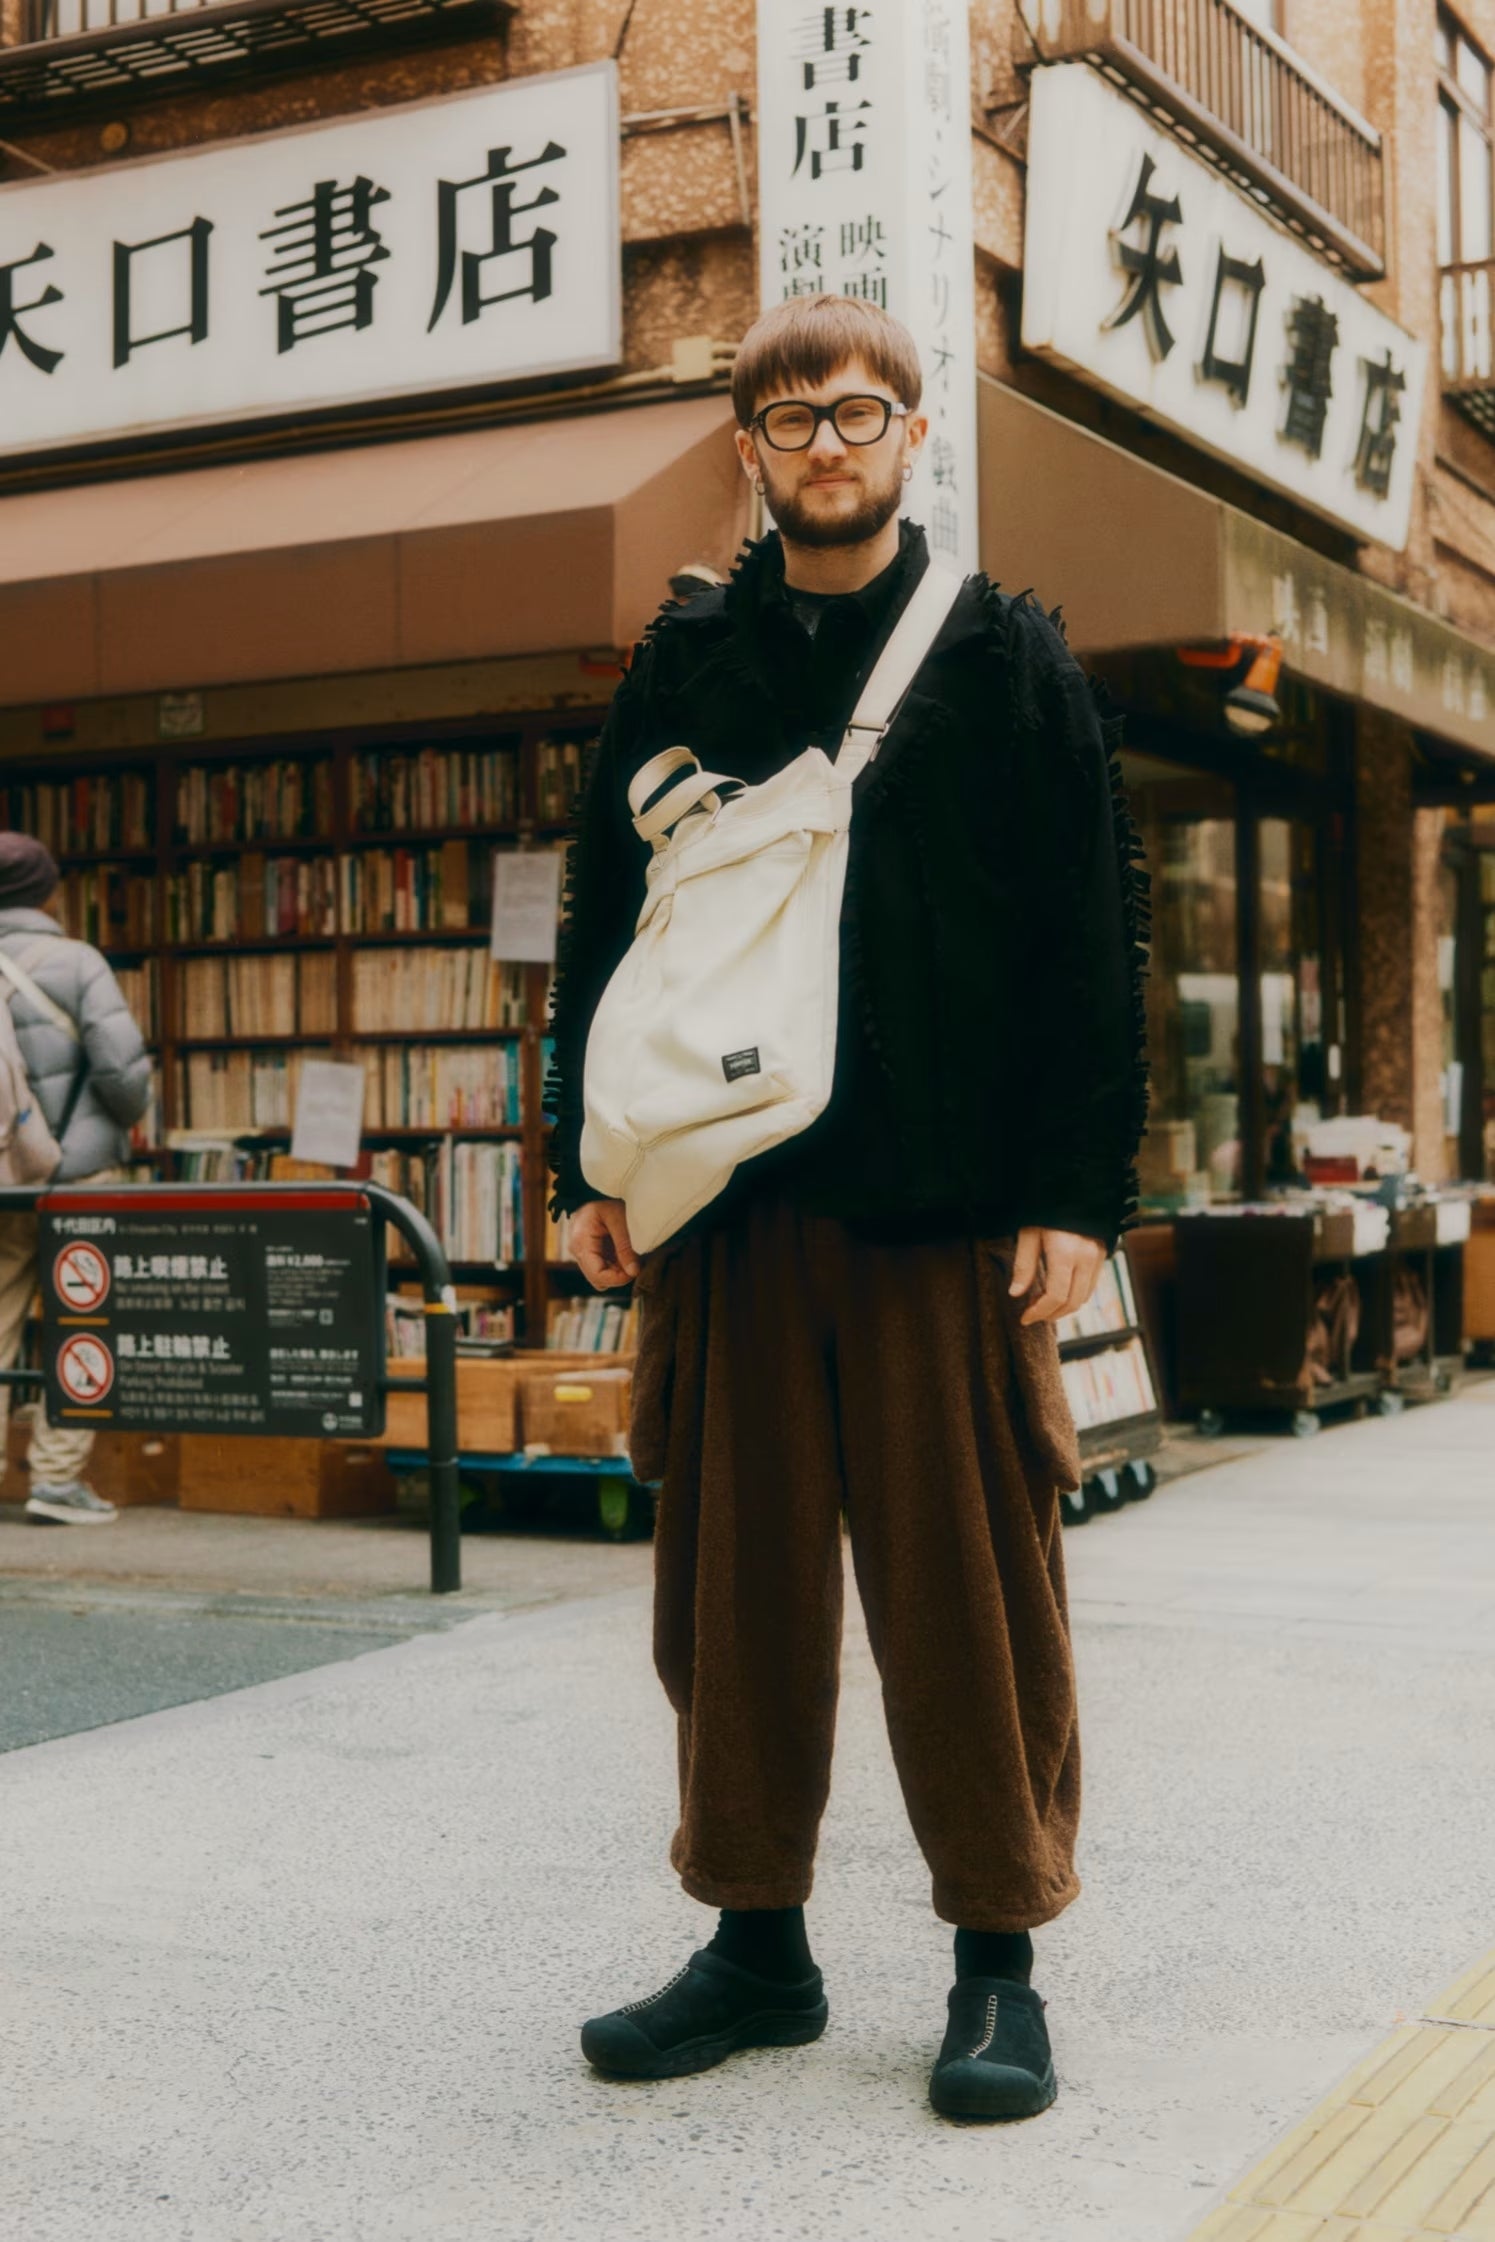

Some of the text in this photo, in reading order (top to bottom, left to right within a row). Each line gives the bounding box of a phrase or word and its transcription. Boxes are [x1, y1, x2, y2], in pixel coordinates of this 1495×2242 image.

[789, 7, 873, 180] 書店
[1101, 151, 1405, 500] 矢口書店
